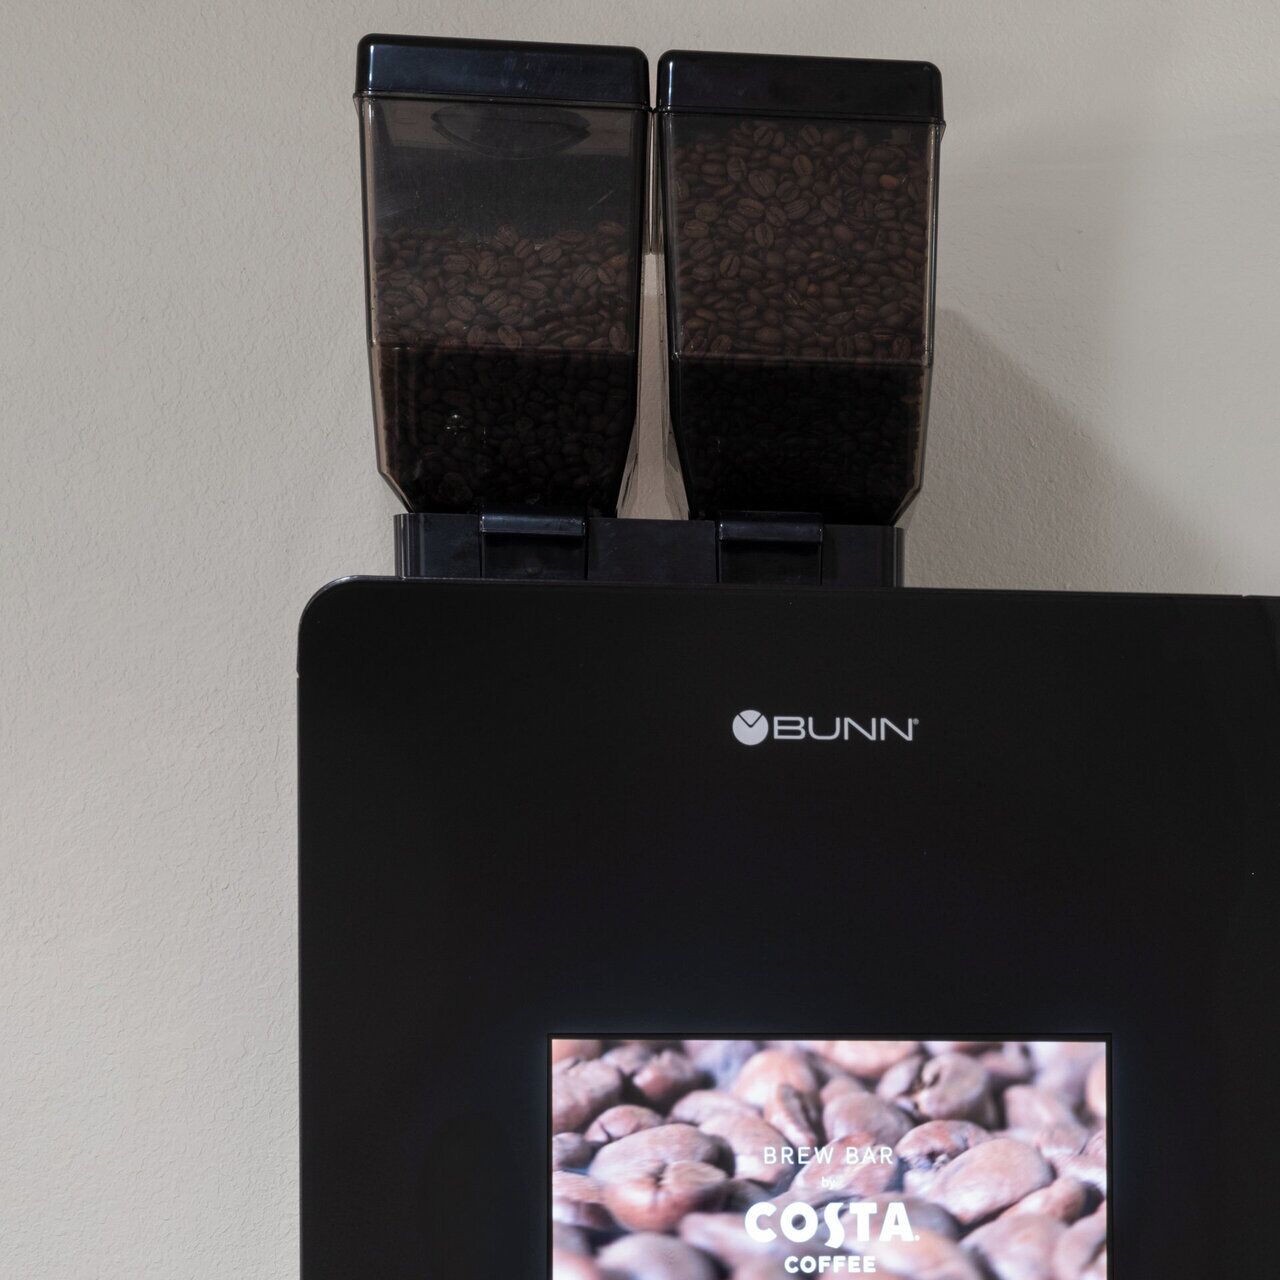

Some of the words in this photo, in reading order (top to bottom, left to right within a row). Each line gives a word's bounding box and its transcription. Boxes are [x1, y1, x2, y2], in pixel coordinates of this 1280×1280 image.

[773, 716, 914, 741] BUNN
[763, 1146, 833, 1165] BREW
[846, 1146, 893, 1165] BAR
[821, 1176, 836, 1190] by
[744, 1201, 917, 1249] COSTA
[784, 1255, 877, 1274] COFFEE
